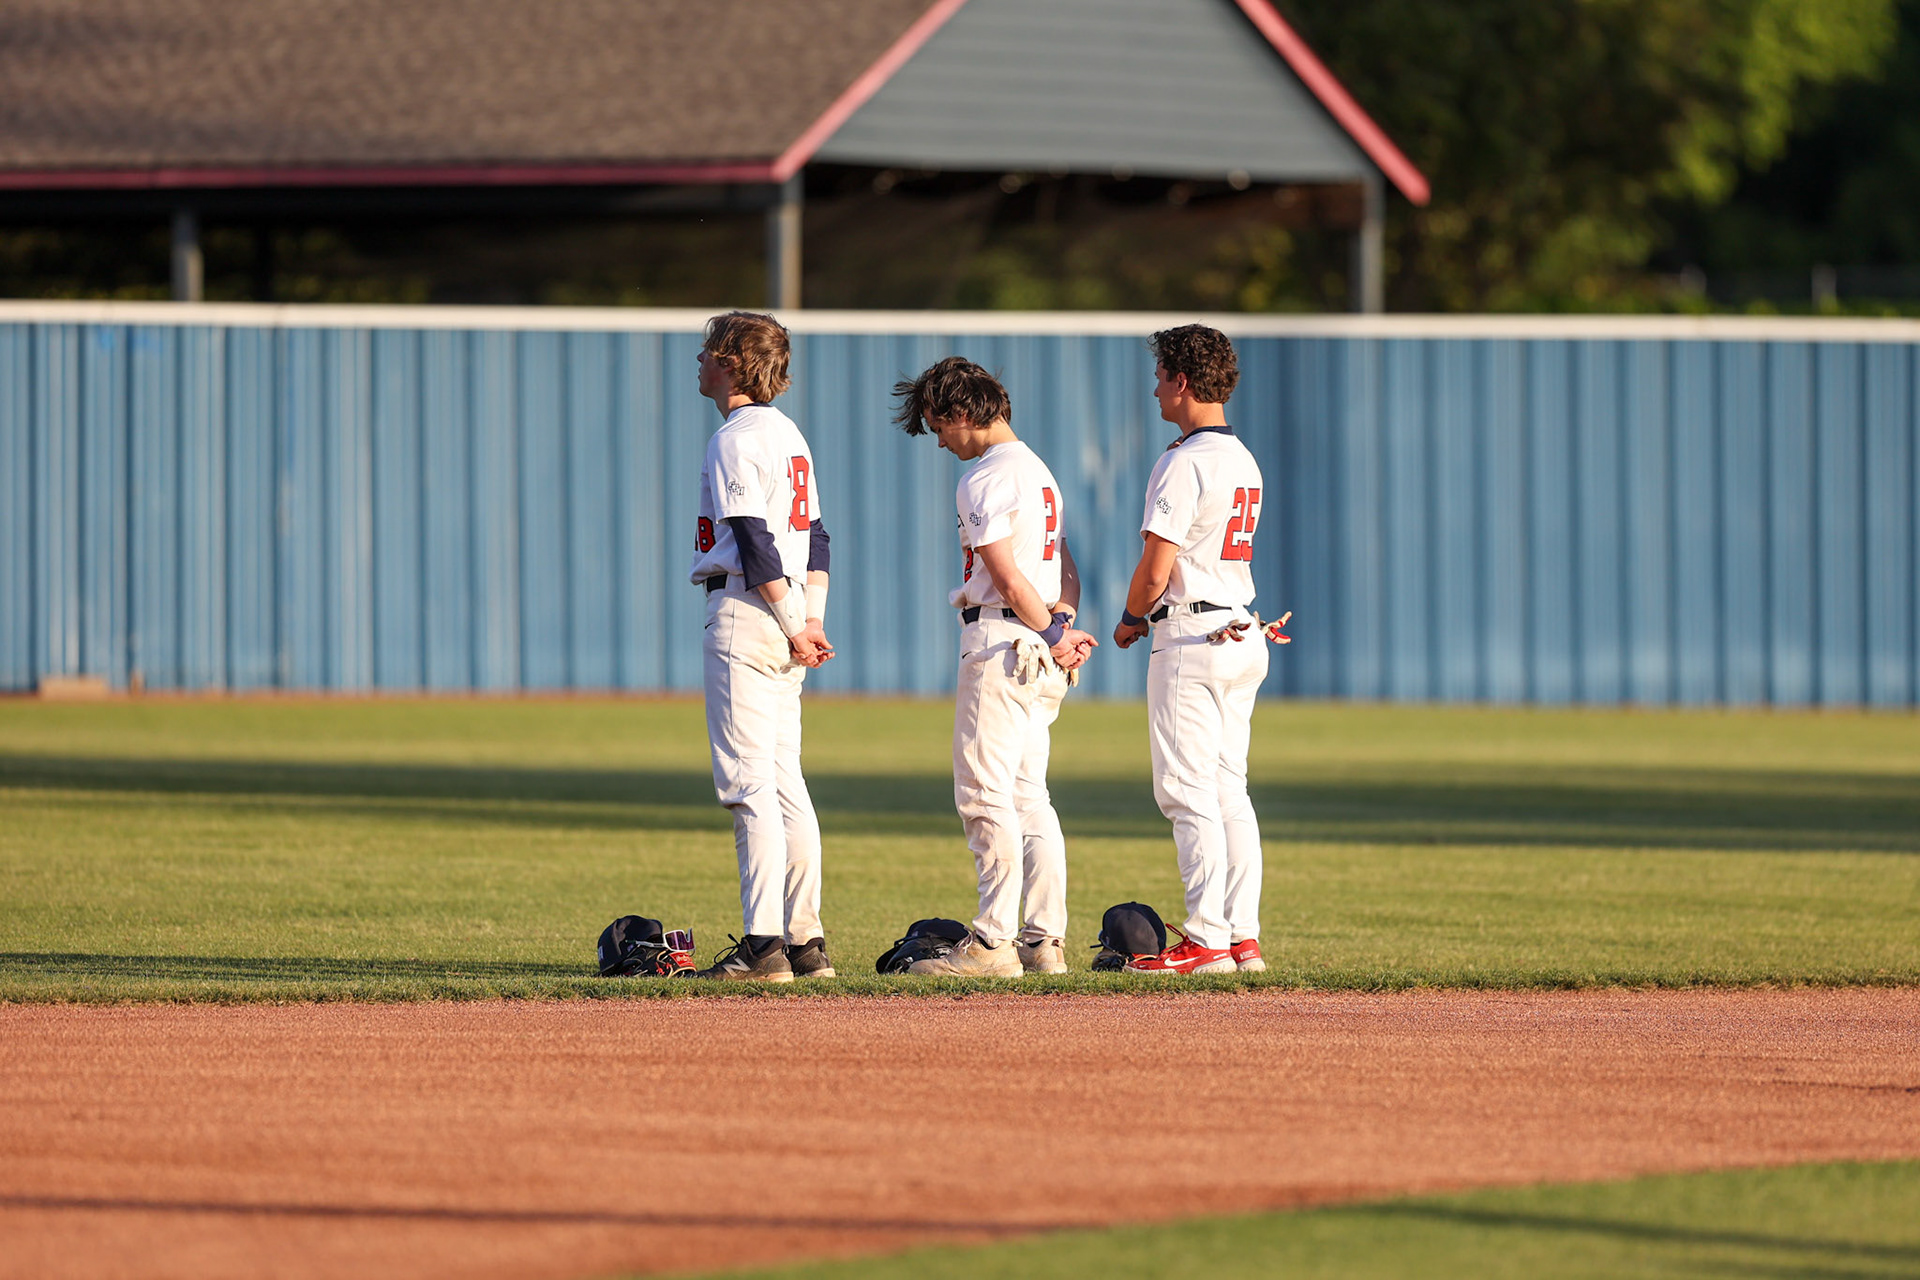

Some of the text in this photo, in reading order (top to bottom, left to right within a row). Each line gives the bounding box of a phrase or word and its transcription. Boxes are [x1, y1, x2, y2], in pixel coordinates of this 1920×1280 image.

[786, 456, 810, 532] 8
[1220, 487, 1260, 561] 25
[695, 516, 716, 552] 8
